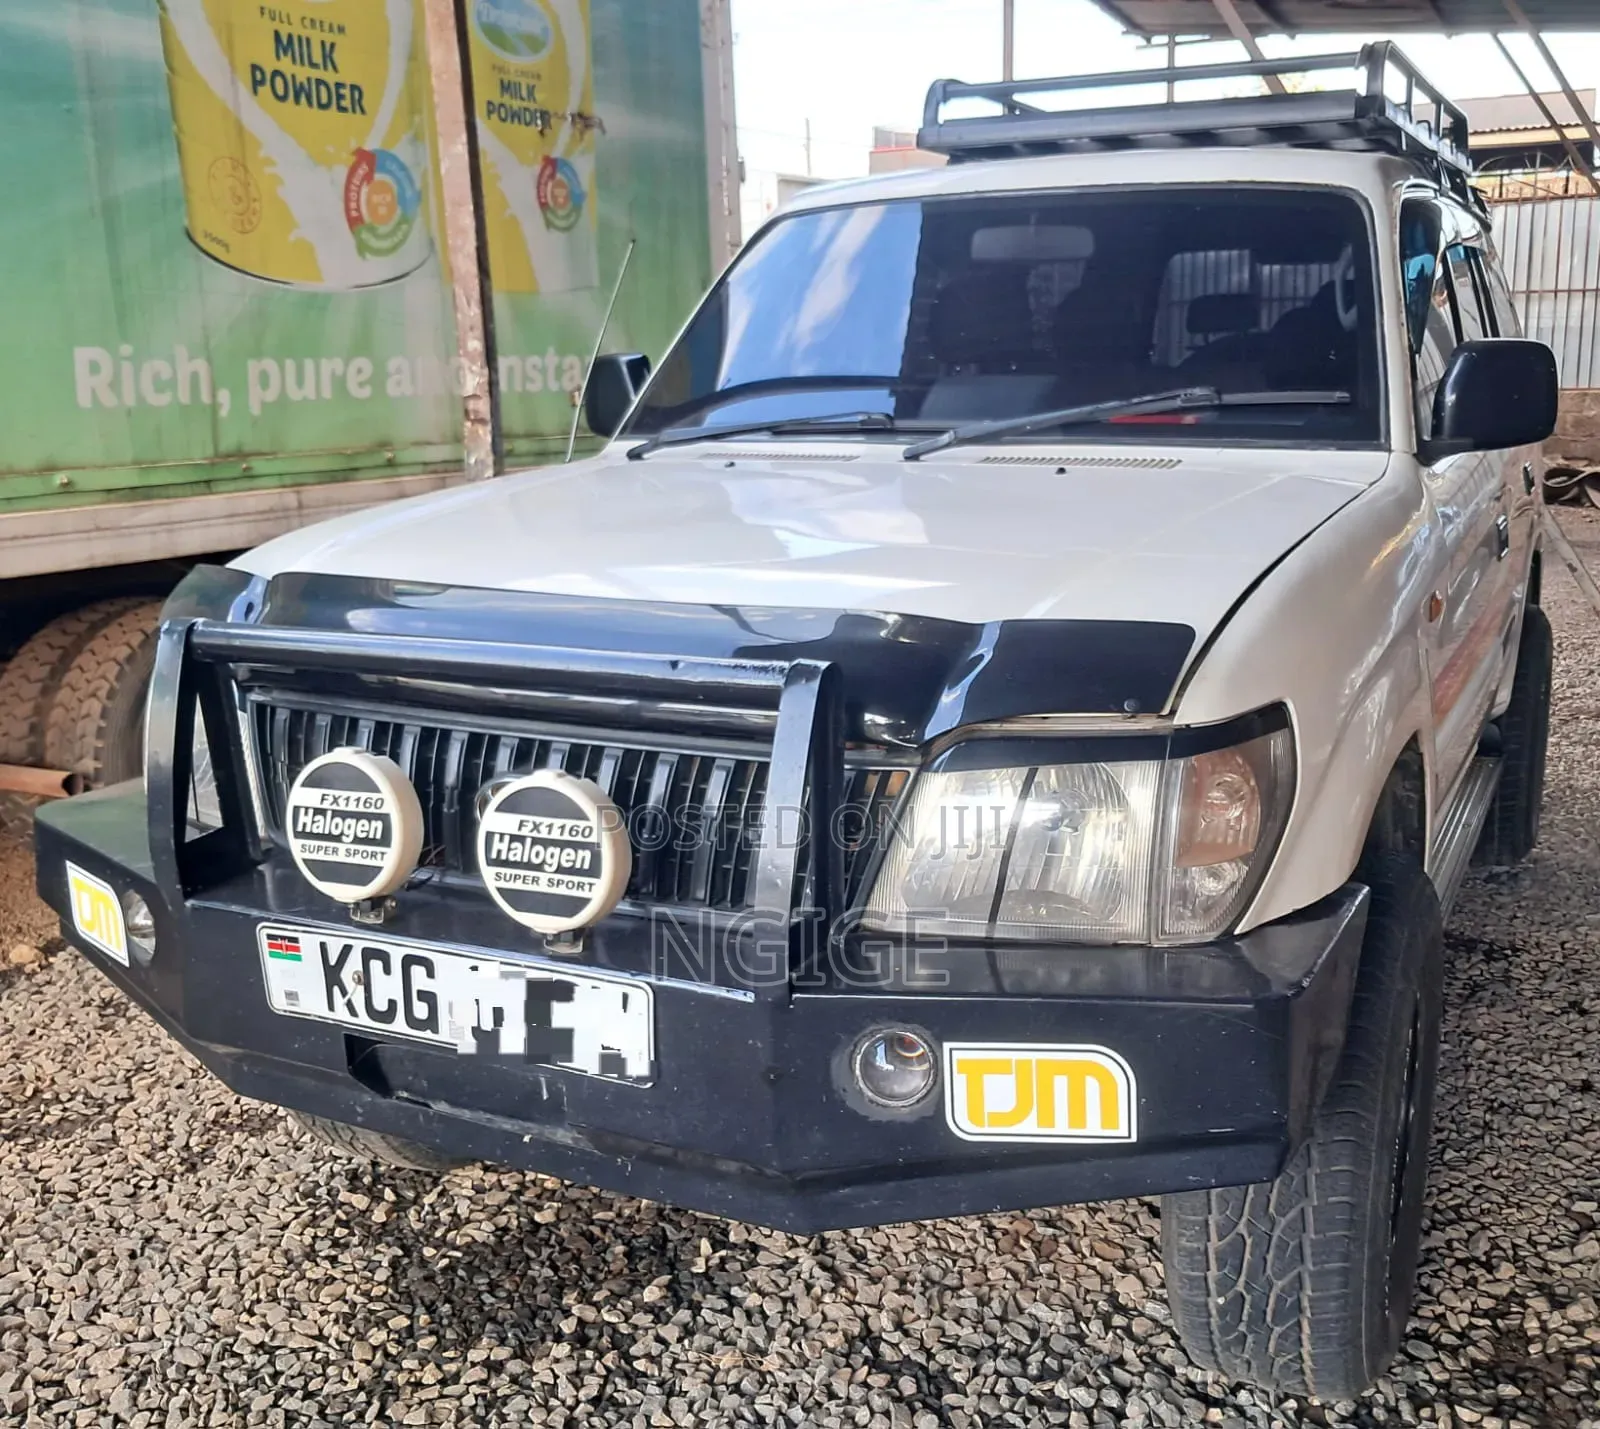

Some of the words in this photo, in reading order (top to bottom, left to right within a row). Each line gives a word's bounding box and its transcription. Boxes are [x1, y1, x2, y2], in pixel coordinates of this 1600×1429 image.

[260, 6, 292, 25] FULL
[301, 16, 346, 35] CREAM
[274, 29, 338, 73] MILK
[250, 63, 366, 115] POWDER
[500, 78, 537, 104] MILK
[486, 100, 552, 130] POWDER
[73, 344, 231, 417] Rich,
[247, 357, 373, 416] pure
[320, 793, 385, 810] FX1160
[296, 807, 383, 843] Halogen
[518, 819, 594, 839] FX1160
[300, 843, 339, 857] SUPER
[344, 848, 387, 862] SPORT
[491, 833, 592, 873] Halogen
[494, 871, 541, 886] SUPER
[547, 877, 596, 893] SPORT
[319, 941, 440, 1035] KCG
[956, 1057, 1120, 1131] TJM
